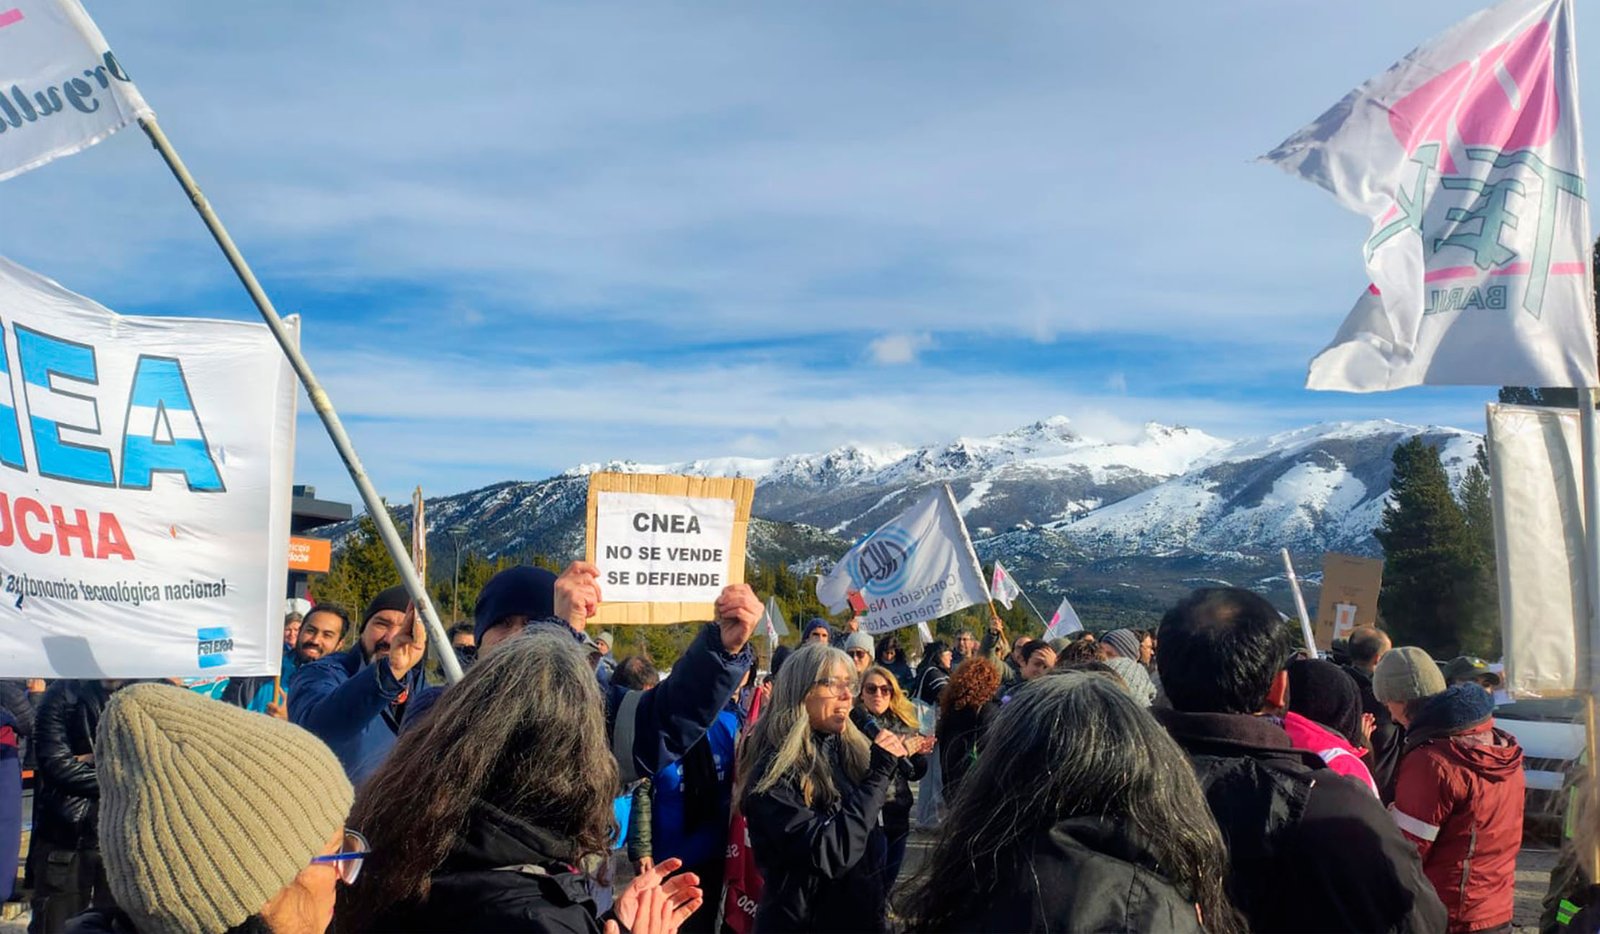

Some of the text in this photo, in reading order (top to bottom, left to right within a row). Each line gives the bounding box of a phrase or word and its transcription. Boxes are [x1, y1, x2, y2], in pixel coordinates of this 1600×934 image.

[632, 512, 701, 535] CNEA
[605, 545, 723, 562] NO SE VENDE
[606, 571, 720, 586] SE DEFIENDE
[79, 579, 161, 606] tecnológica
[164, 578, 227, 601] nacional
